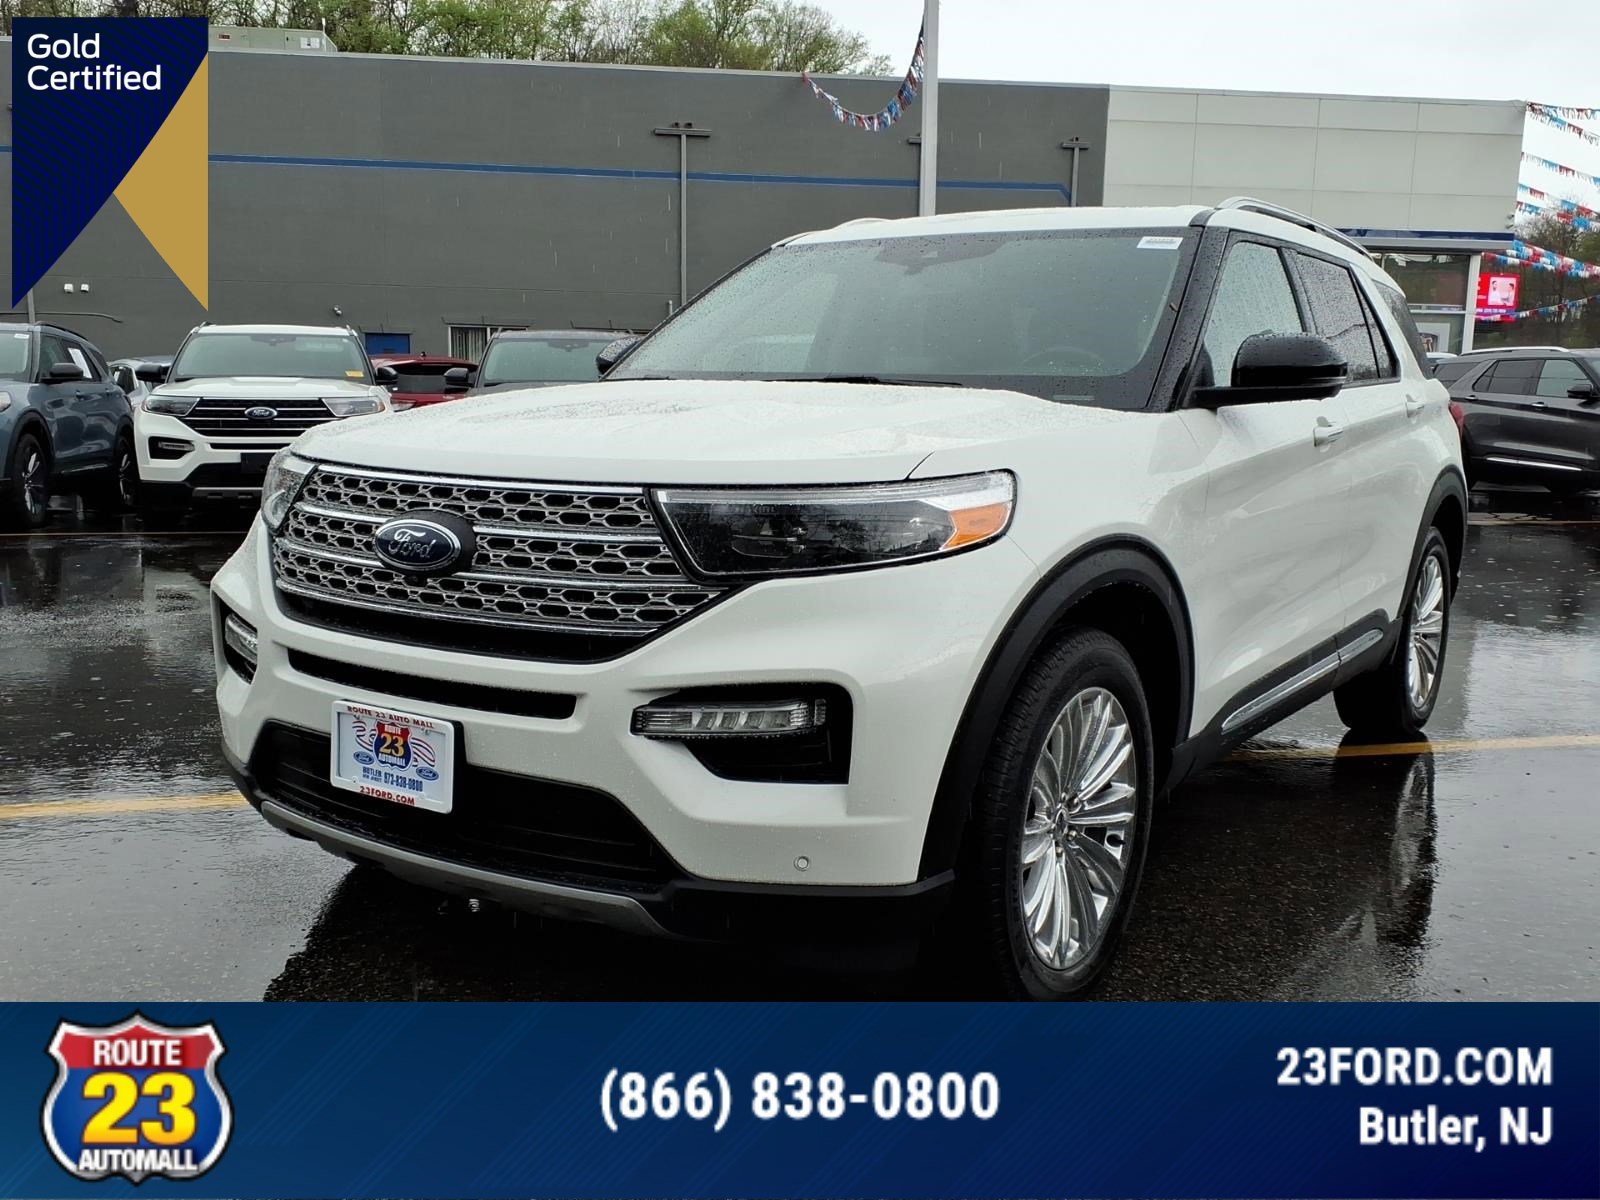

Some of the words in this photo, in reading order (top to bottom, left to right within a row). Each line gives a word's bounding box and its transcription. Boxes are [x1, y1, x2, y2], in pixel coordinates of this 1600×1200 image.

[388, 528, 436, 558] Ford
[347, 705, 372, 716] ROUTE
[375, 711, 386, 719] 23
[389, 713, 410, 724] AUTO
[413, 719, 434, 729] MALL
[379, 732, 404, 757] 23
[360, 785, 415, 806] 23FORD.COM
